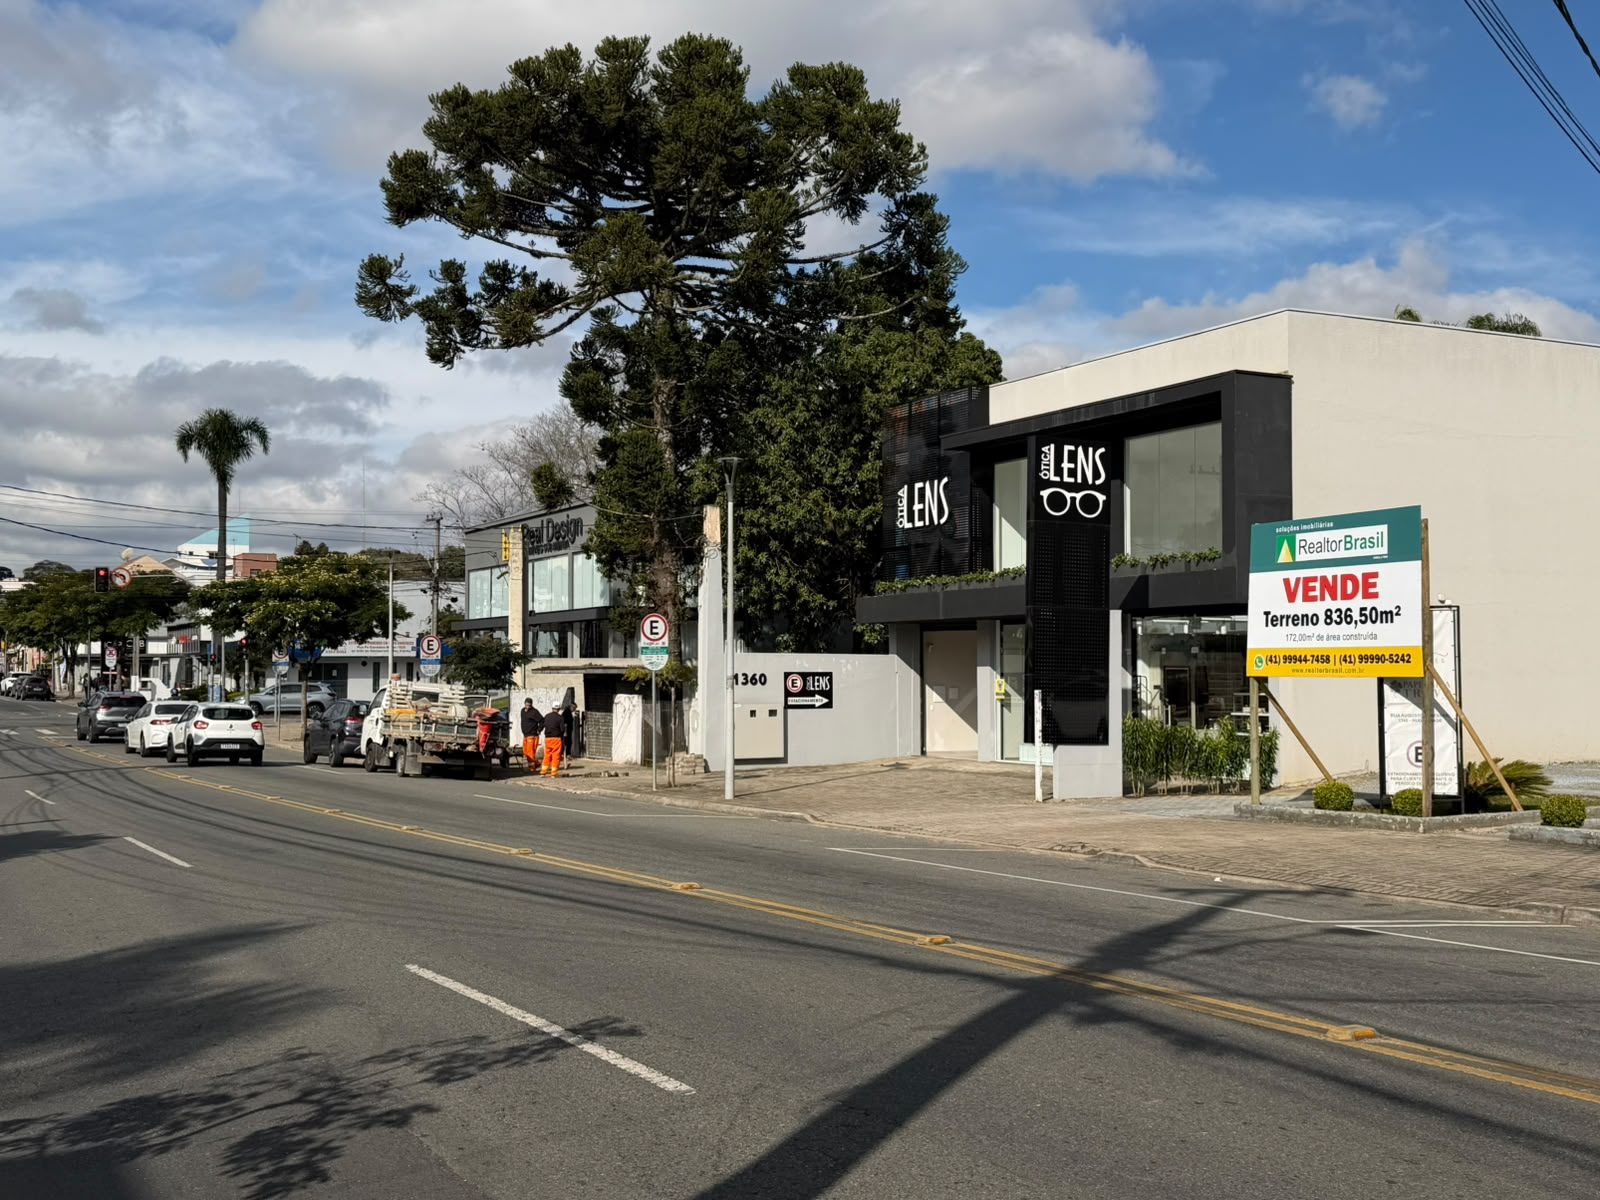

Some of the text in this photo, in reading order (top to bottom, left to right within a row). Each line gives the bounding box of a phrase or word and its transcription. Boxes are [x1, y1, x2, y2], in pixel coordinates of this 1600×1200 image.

[1039, 444, 1106, 485] ÓTICA LENS
[904, 476, 950, 529] LENS
[546, 514, 584, 544] Design
[1276, 521, 1334, 534] soluções imobiliárias
[1298, 530, 1384, 555] RealtorBrasil
[1282, 572, 1380, 604] VENDE
[1264, 605, 1402, 629] Terreno 836,50m²
[650, 620, 659, 635] E
[1326, 632, 1340, 641] área
[1342, 632, 1378, 641] construída
[427, 640, 434, 650] E
[1265, 654, 1281, 666] (41)
[1282, 654, 1330, 665] 99944-7458
[1339, 654, 1356, 666] (41)
[1358, 654, 1412, 664] 99990-5242
[733, 672, 767, 686] 1360
[791, 678, 798, 688] E
[810, 676, 830, 691] LENS
